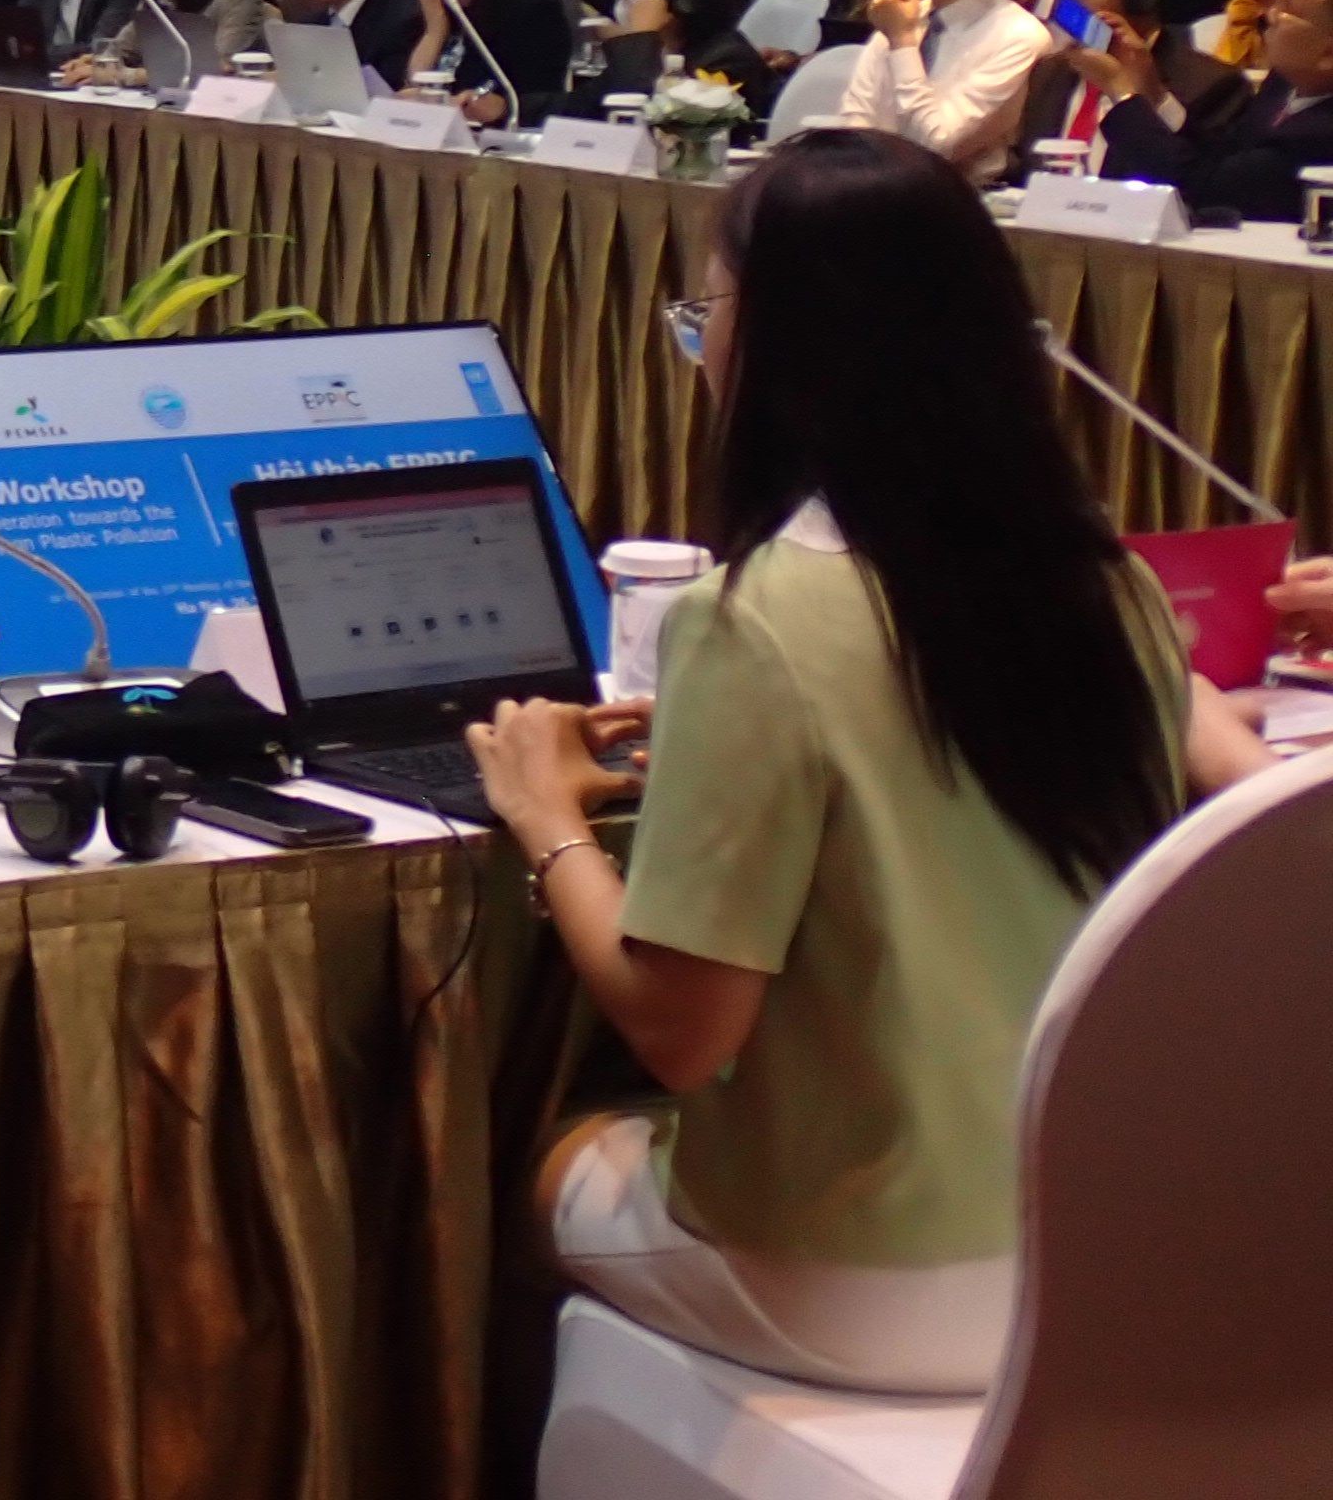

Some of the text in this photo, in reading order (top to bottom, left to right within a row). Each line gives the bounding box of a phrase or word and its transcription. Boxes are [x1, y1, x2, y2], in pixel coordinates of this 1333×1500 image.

[5, 425, 69, 440] PEMSEA
[68, 506, 141, 526] towards
[143, 504, 175, 521] the
[38, 532, 98, 549] Plastic
[103, 527, 178, 544] Pollution
